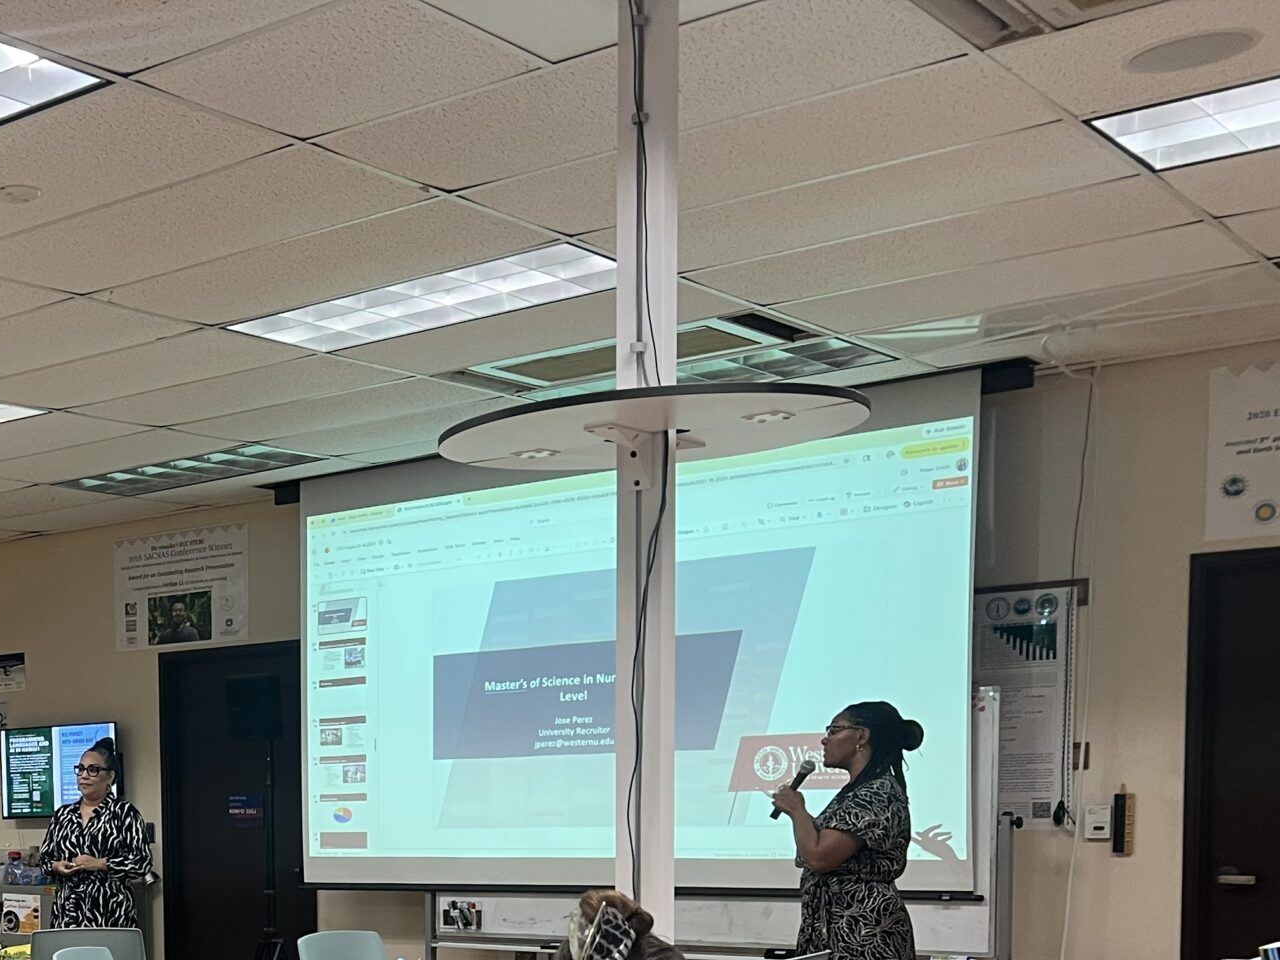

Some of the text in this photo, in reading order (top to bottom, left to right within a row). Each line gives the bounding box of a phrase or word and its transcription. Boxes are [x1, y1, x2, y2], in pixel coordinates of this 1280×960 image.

[1247, 411, 1270, 420] 2020
[170, 546, 207, 557] Conference
[208, 543, 233, 552] Winner
[484, 679, 528, 692] Master's
[529, 677, 540, 688] of
[542, 675, 580, 688] Science
[583, 673, 593, 684] in
[560, 690, 587, 701] Level
[555, 715, 593, 725] Jose Perez
[538, 726, 611, 737] University Recruiter
[534, 737, 615, 750] jperez@westernu.edu
